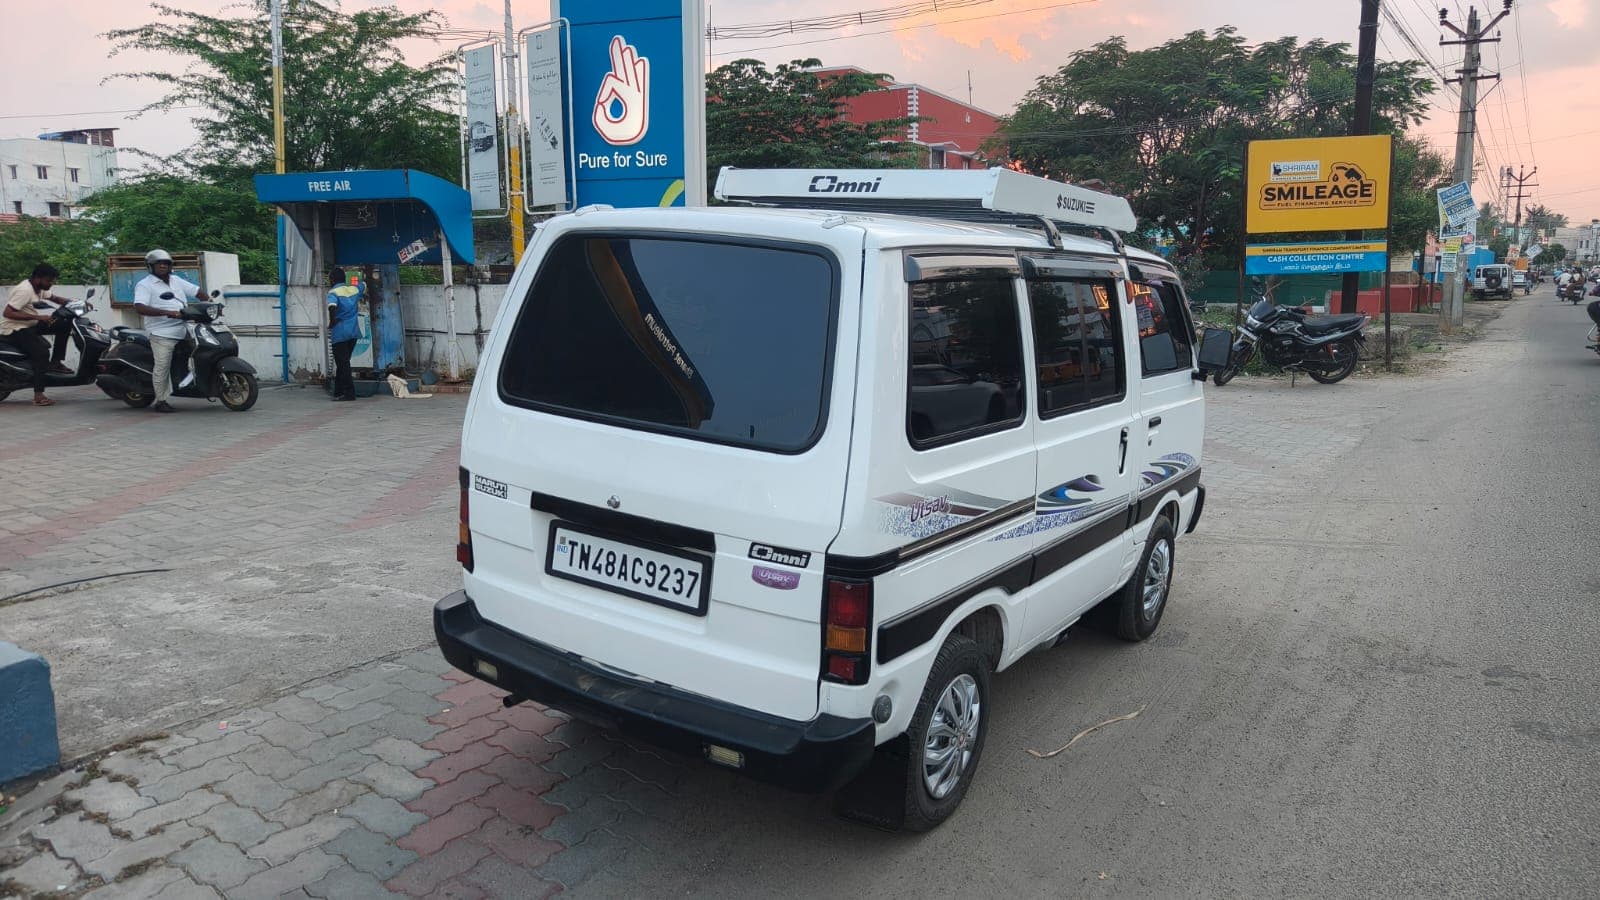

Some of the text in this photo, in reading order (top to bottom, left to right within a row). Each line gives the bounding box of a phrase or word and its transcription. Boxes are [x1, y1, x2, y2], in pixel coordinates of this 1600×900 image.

[579, 150, 668, 168] Pure for Sure
[1282, 164, 1318, 172] SHRIRAM
[308, 180, 352, 192] FREE AIR
[808, 175, 882, 193] Omni
[1263, 183, 1373, 202] SMILEAGE
[1062, 196, 1087, 213] SUZUKI
[1267, 255, 1288, 263] CASH
[1289, 254, 1335, 262] COLLECTION
[475, 475, 507, 492] MARUTI
[475, 483, 507, 499] SUZUKI
[751, 544, 808, 567] Omni
[557, 540, 700, 599] IND TN48AC9237
